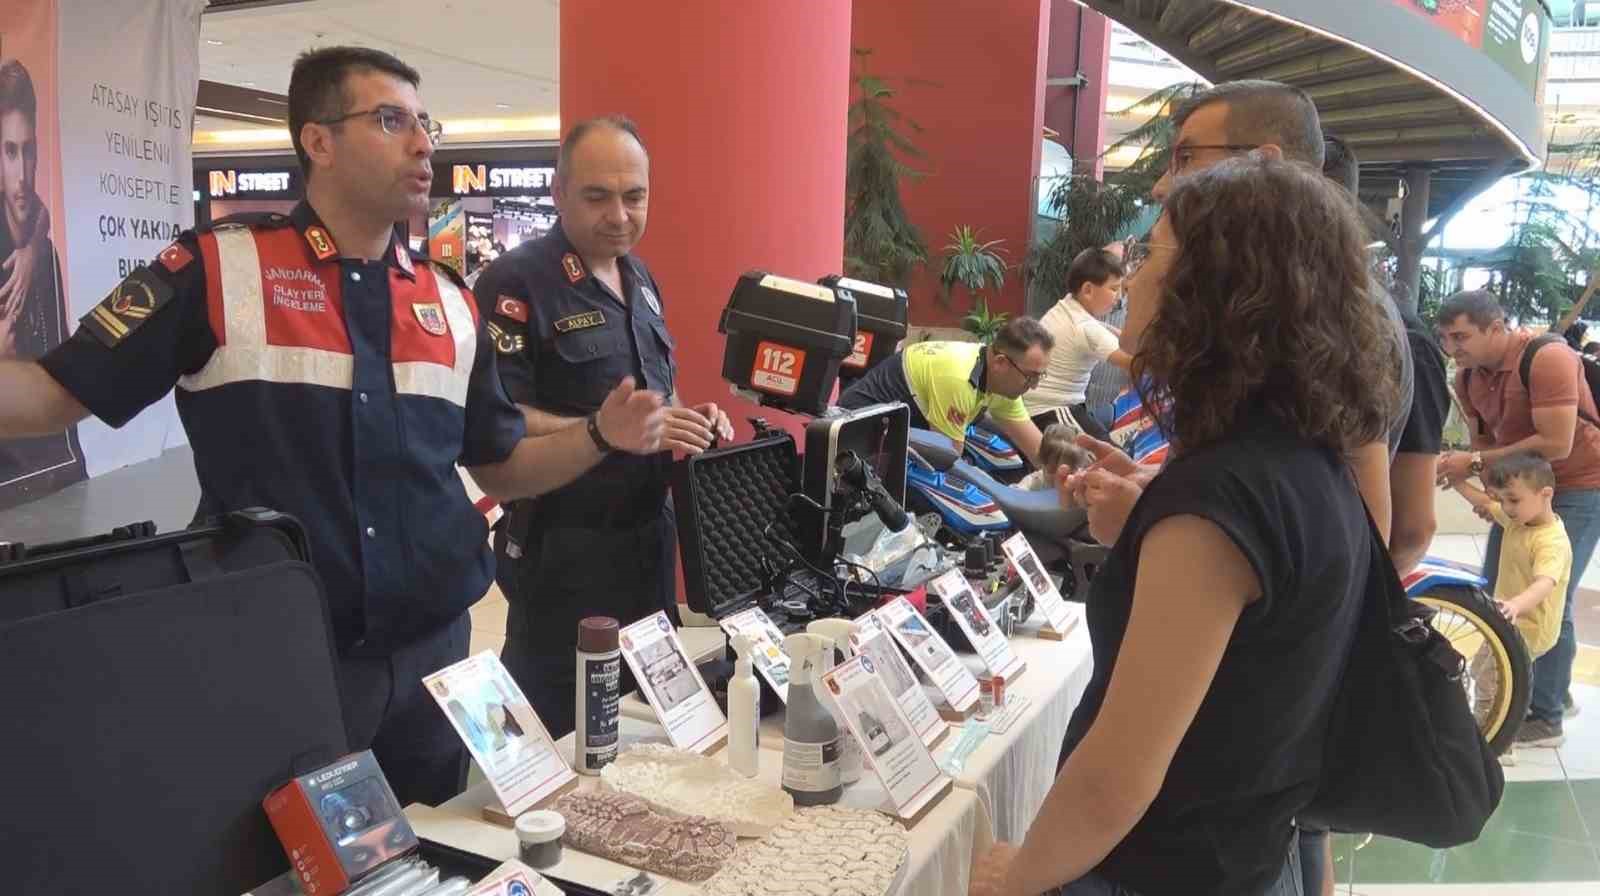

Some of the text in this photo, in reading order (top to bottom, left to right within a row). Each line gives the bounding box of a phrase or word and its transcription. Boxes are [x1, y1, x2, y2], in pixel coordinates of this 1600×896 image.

[90, 83, 138, 118] ATASAY
[208, 170, 290, 197] IN STREET
[453, 164, 555, 194] IN STREET
[99, 214, 126, 242] ÇOK
[273, 283, 299, 300] OLAY
[762, 347, 797, 375] 112
